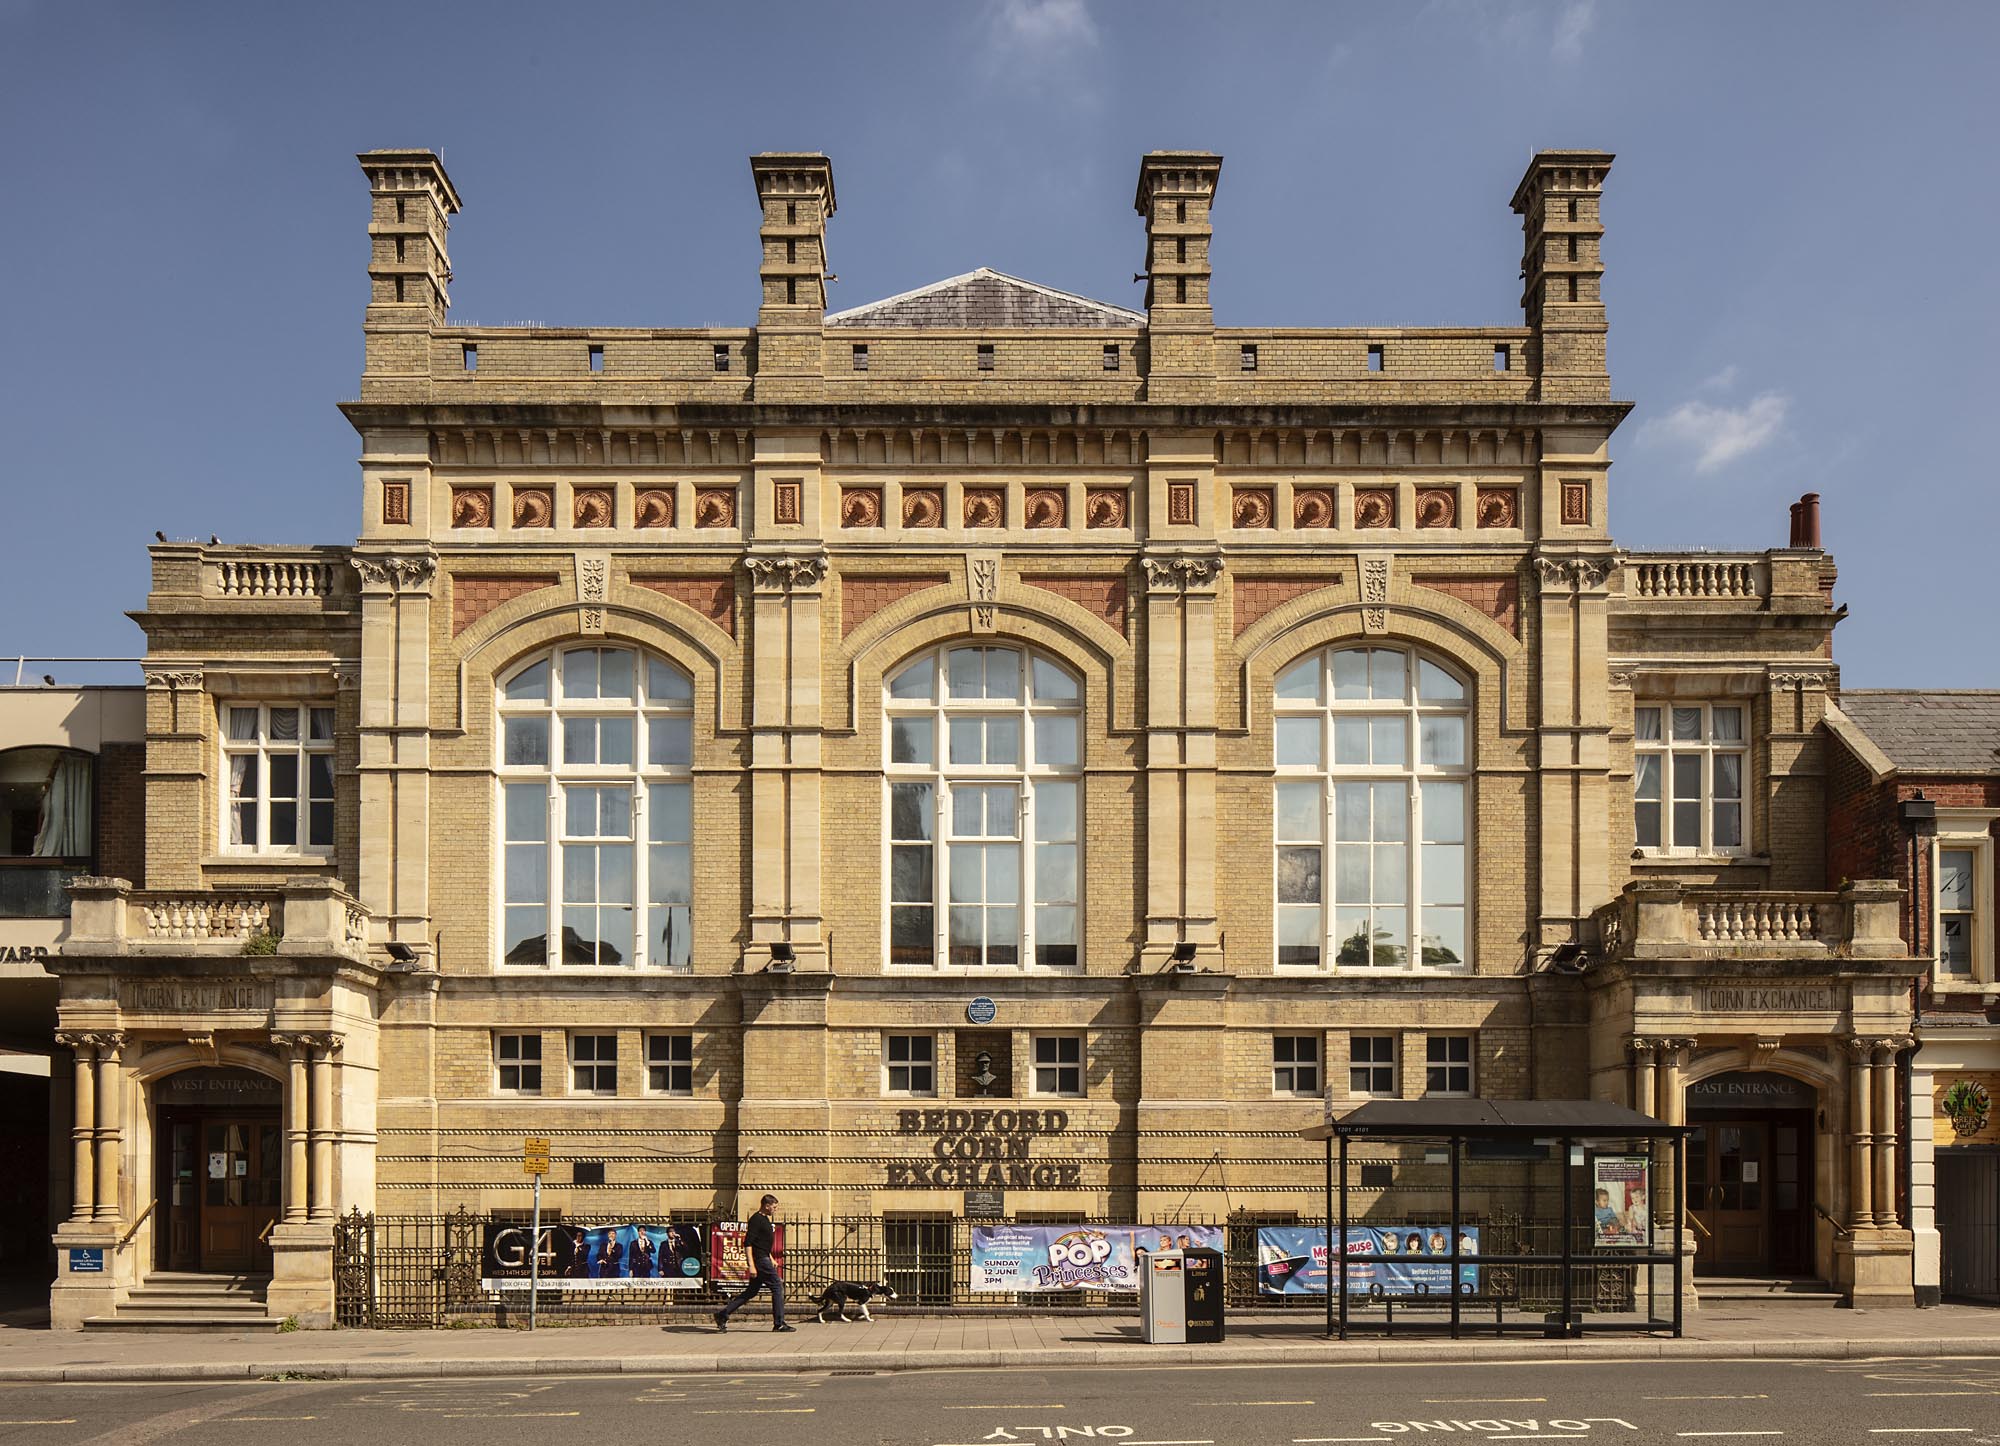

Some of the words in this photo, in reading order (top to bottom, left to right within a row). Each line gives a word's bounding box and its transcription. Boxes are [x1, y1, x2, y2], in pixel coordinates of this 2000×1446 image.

[180, 986, 253, 1008] EXCHANGE
[1710, 990, 1744, 1009] CORN
[171, 1079, 206, 1090] WEST
[208, 1079, 274, 1090] ENTRANCE
[1695, 1082, 1726, 1094] EAST
[1728, 1082, 1795, 1094] ENTRANCE
[896, 1108, 1069, 1132] BEDFORD
[934, 1136, 1032, 1158] CORN
[887, 1163, 1081, 1186] EXCHANGE
[720, 1222, 739, 1231] OPEN
[493, 1228, 557, 1267] G4
[1048, 1239, 1112, 1267] POP
[1313, 1241, 1373, 1258] Meoause
[528, 1257, 547, 1266] LVE
[1033, 1265, 1128, 1287] Princesses
[983, 1425, 1134, 1440] ONLY
[1370, 1418, 1638, 1433] LOADING
